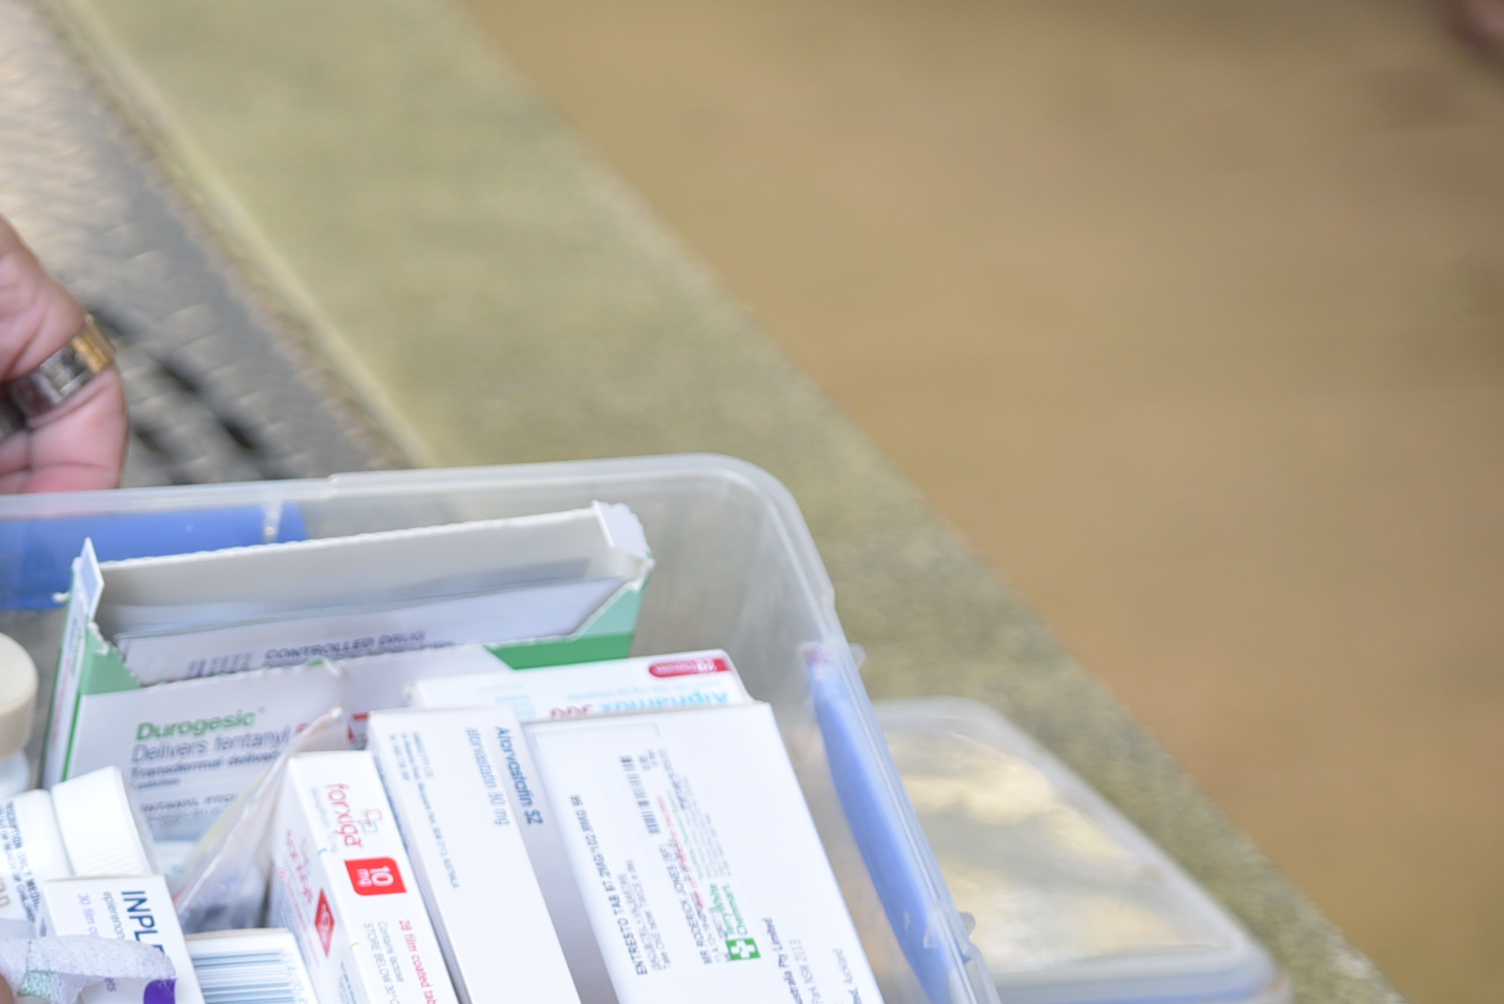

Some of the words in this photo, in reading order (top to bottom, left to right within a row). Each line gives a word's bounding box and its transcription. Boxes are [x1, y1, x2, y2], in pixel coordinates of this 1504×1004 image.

[135, 711, 256, 740] Durogesic
[131, 738, 208, 762] Delivers
[213, 726, 290, 752] fentanyl
[464, 724, 500, 788] atorvastatin
[491, 807, 510, 828] mg
[493, 723, 537, 808] Atorvastatin
[523, 807, 543, 827] SZ
[320, 780, 365, 849] forxiga
[354, 867, 372, 889] mg
[369, 863, 394, 889] 10
[665, 862, 686, 896] JONES
[607, 893, 624, 915] TAB
[631, 880, 649, 909] TWICE
[707, 882, 738, 939] TerryWhite
[119, 884, 167, 961] INPL
[399, 917, 412, 931] 28
[650, 929, 664, 950] ONE
[679, 897, 706, 948] RODERICK
[760, 916, 783, 950] Limited
[362, 921, 381, 952] STORE
[373, 951, 392, 984] BELOW
[377, 920, 397, 956] Contains
[389, 957, 405, 983] lactose
[403, 931, 421, 953] film
[616, 916, 648, 975] ENTRESTO
[699, 949, 712, 965] MR
[411, 952, 432, 988] coated
[774, 952, 791, 967] Pty
